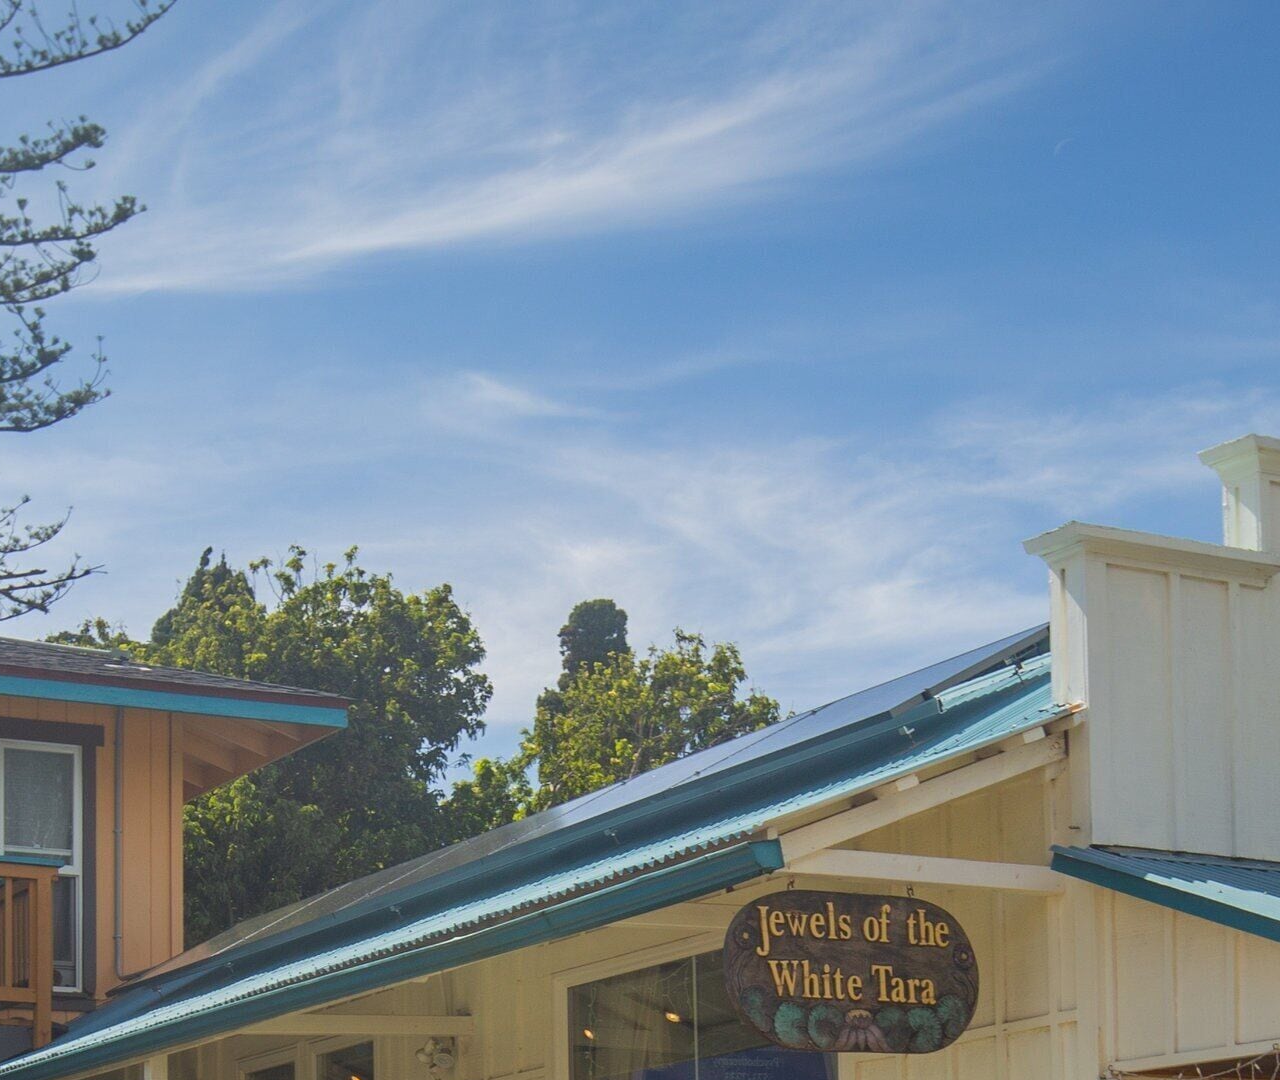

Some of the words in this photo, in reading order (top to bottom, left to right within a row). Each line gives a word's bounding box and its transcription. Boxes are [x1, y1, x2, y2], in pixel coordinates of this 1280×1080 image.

[756, 901, 852, 957] Jewels
[863, 904, 890, 943] of
[907, 908, 950, 948] the
[768, 959, 863, 1001] White
[871, 964, 937, 1006] Tara
